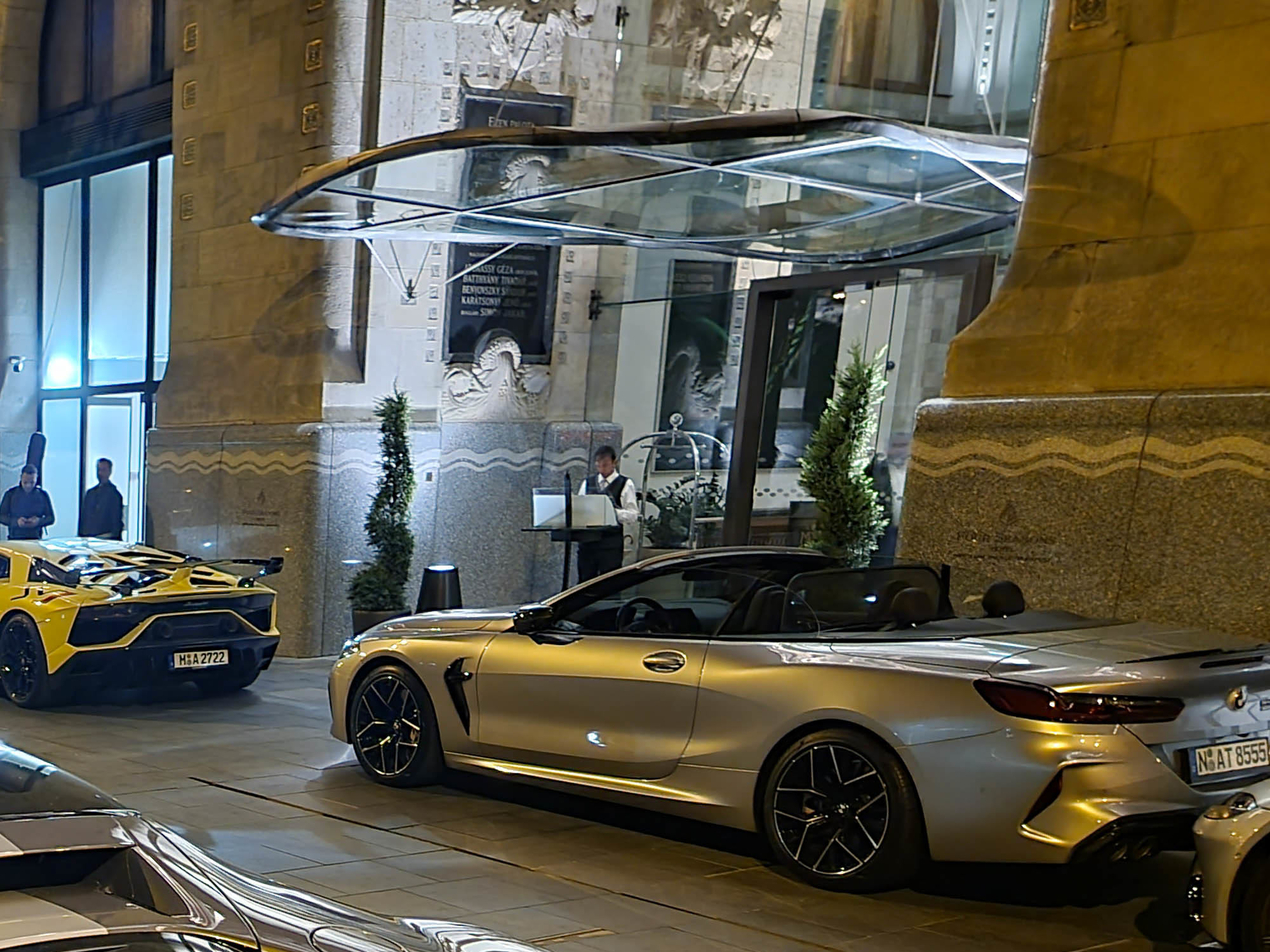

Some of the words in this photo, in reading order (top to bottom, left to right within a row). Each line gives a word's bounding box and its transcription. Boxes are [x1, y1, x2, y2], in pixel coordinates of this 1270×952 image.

[200, 651, 225, 664] 2722
[1217, 748, 1232, 771] AT
[1235, 742, 1266, 767] 8555
